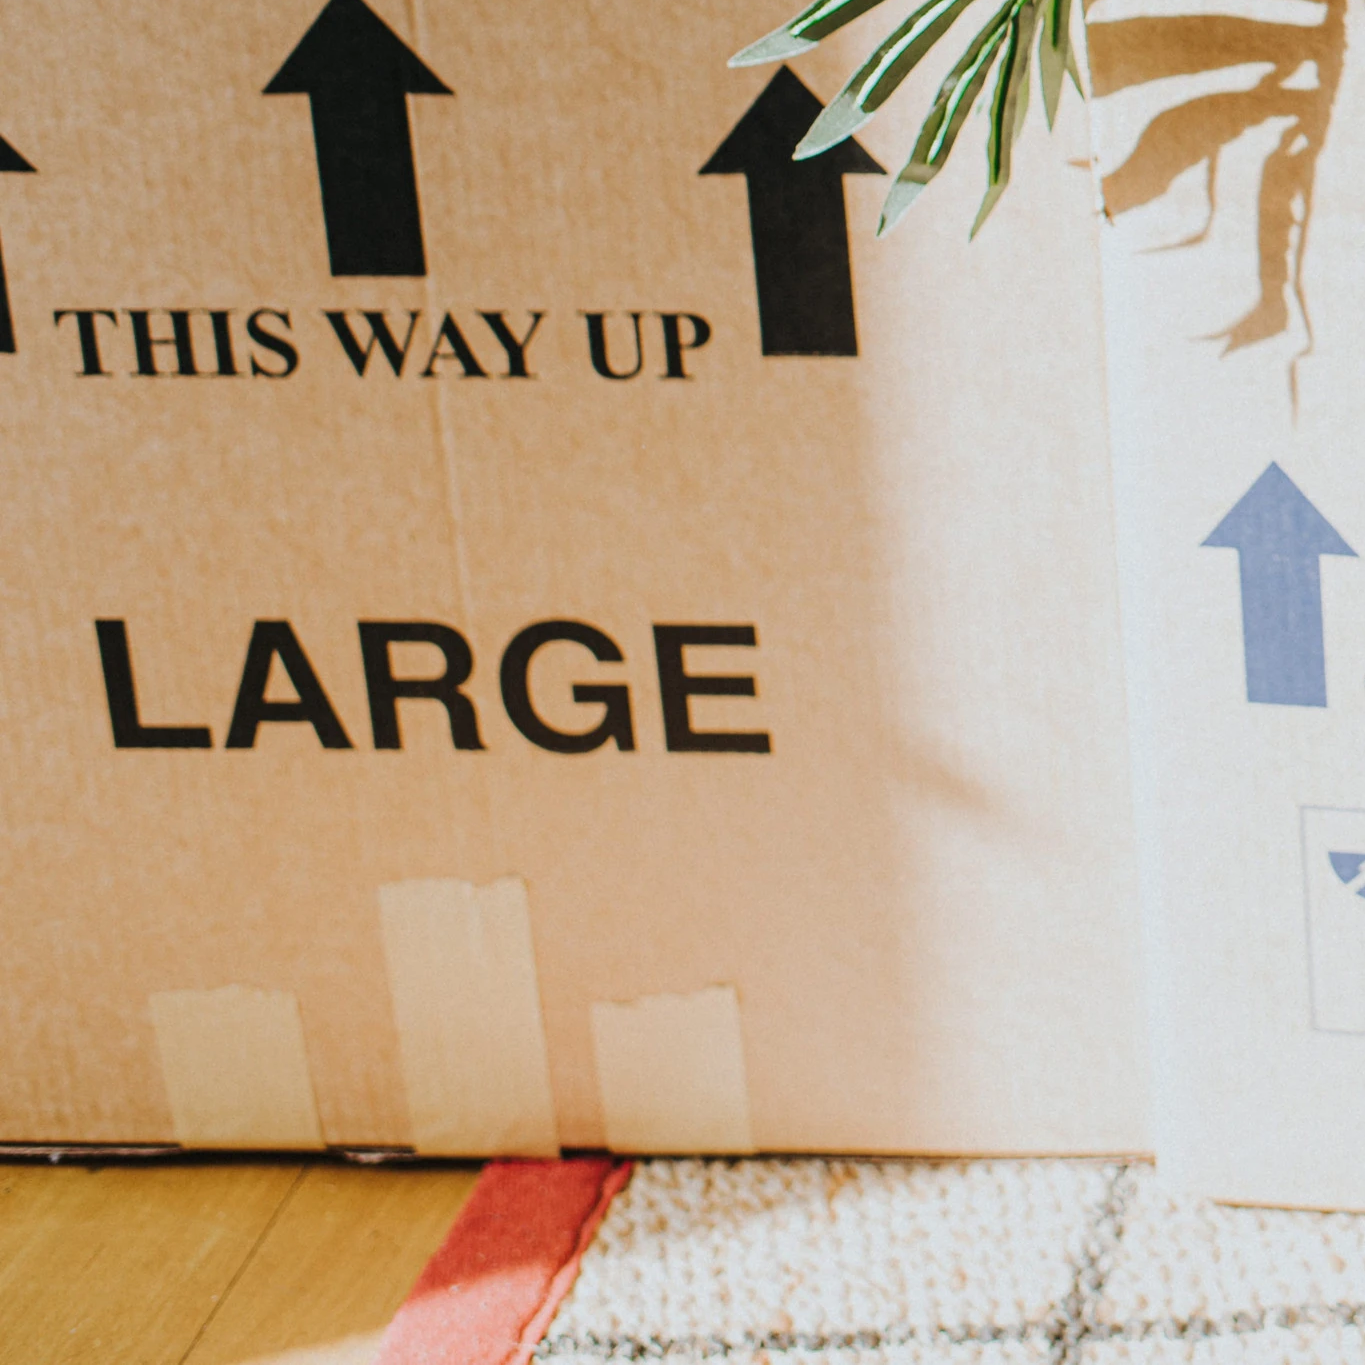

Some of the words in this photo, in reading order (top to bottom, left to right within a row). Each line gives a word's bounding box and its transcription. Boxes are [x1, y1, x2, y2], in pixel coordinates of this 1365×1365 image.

[53, 308, 300, 379] THIS
[320, 309, 547, 380] WAY
[583, 310, 713, 381] UP
[94, 618, 773, 754] LARGE
